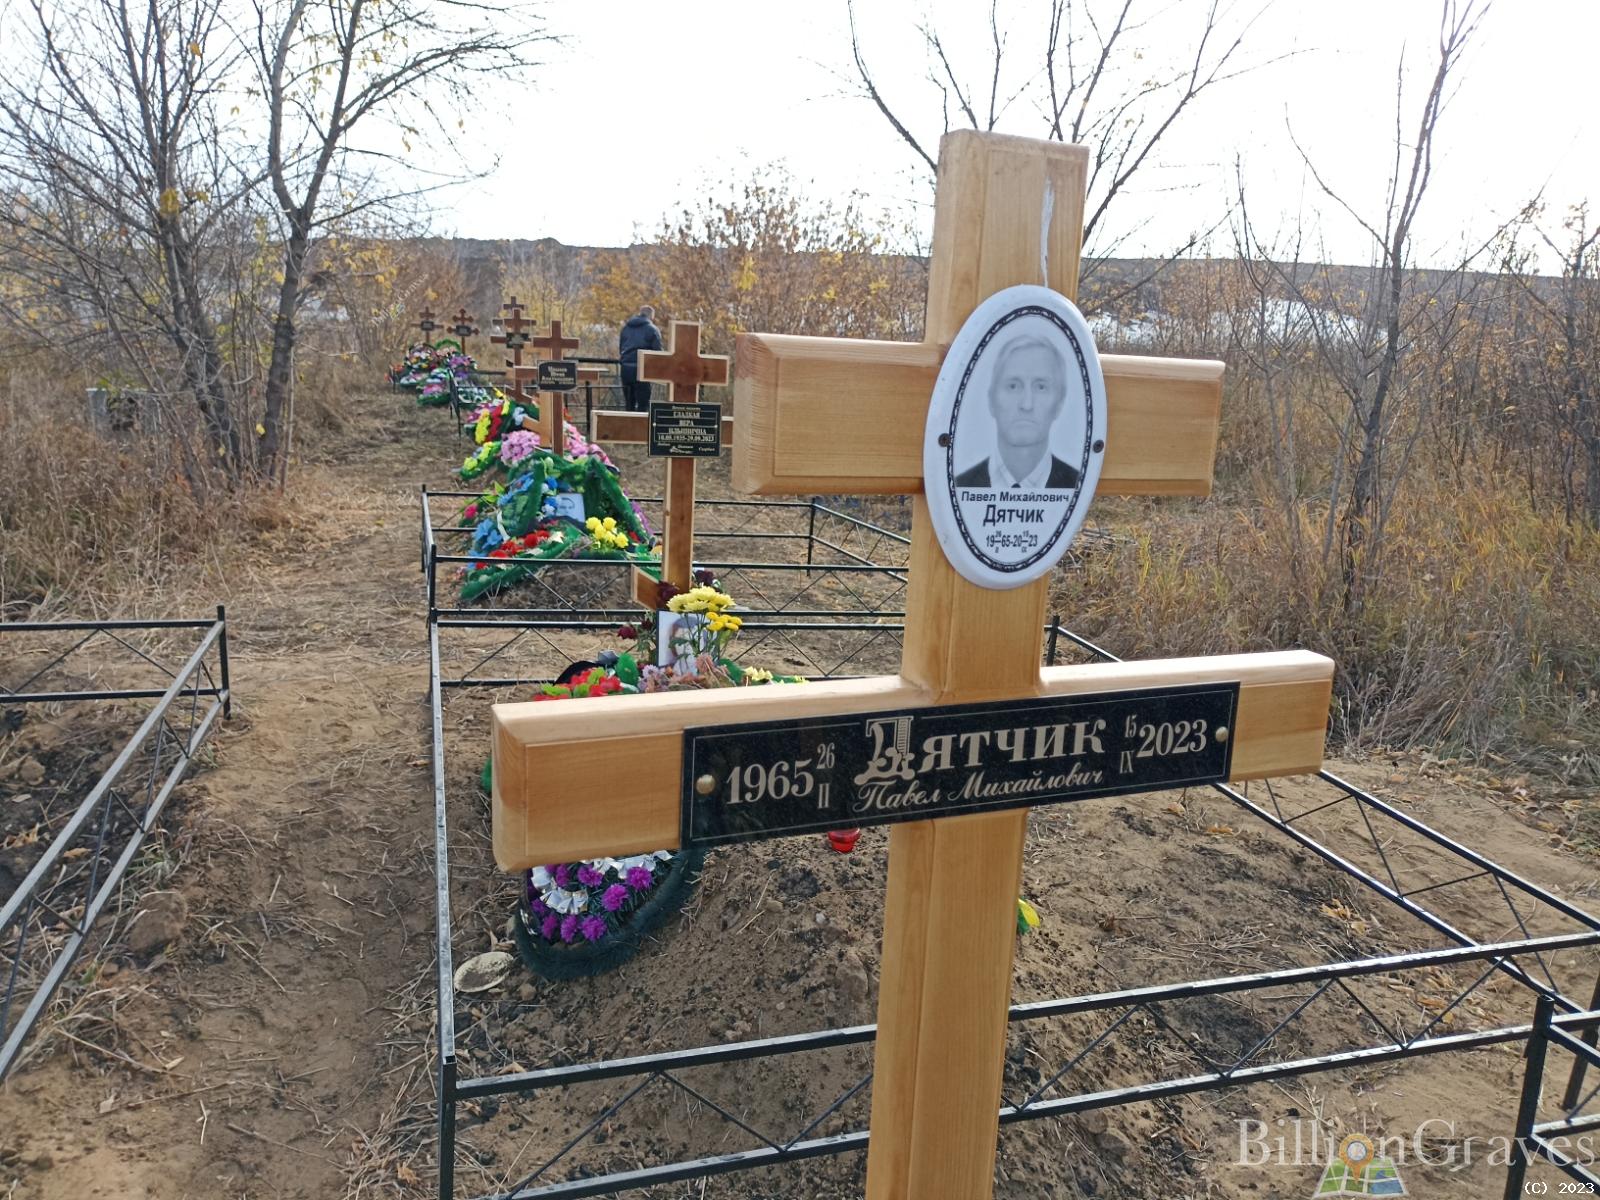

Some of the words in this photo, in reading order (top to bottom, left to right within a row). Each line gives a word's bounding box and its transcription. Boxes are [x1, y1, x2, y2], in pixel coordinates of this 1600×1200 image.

[961, 491, 996, 502] Павел
[999, 491, 1069, 502] Михайлович
[983, 504, 1045, 527] Дятчик
[1124, 714, 1138, 739] 15
[726, 759, 814, 805] 1965
[1137, 718, 1208, 759] 2023
[817, 742, 835, 771] 26
[1119, 748, 1134, 775] IX
[818, 781, 830, 810] II
[852, 778, 943, 813] Павел
[947, 763, 1104, 800] Михайлович
